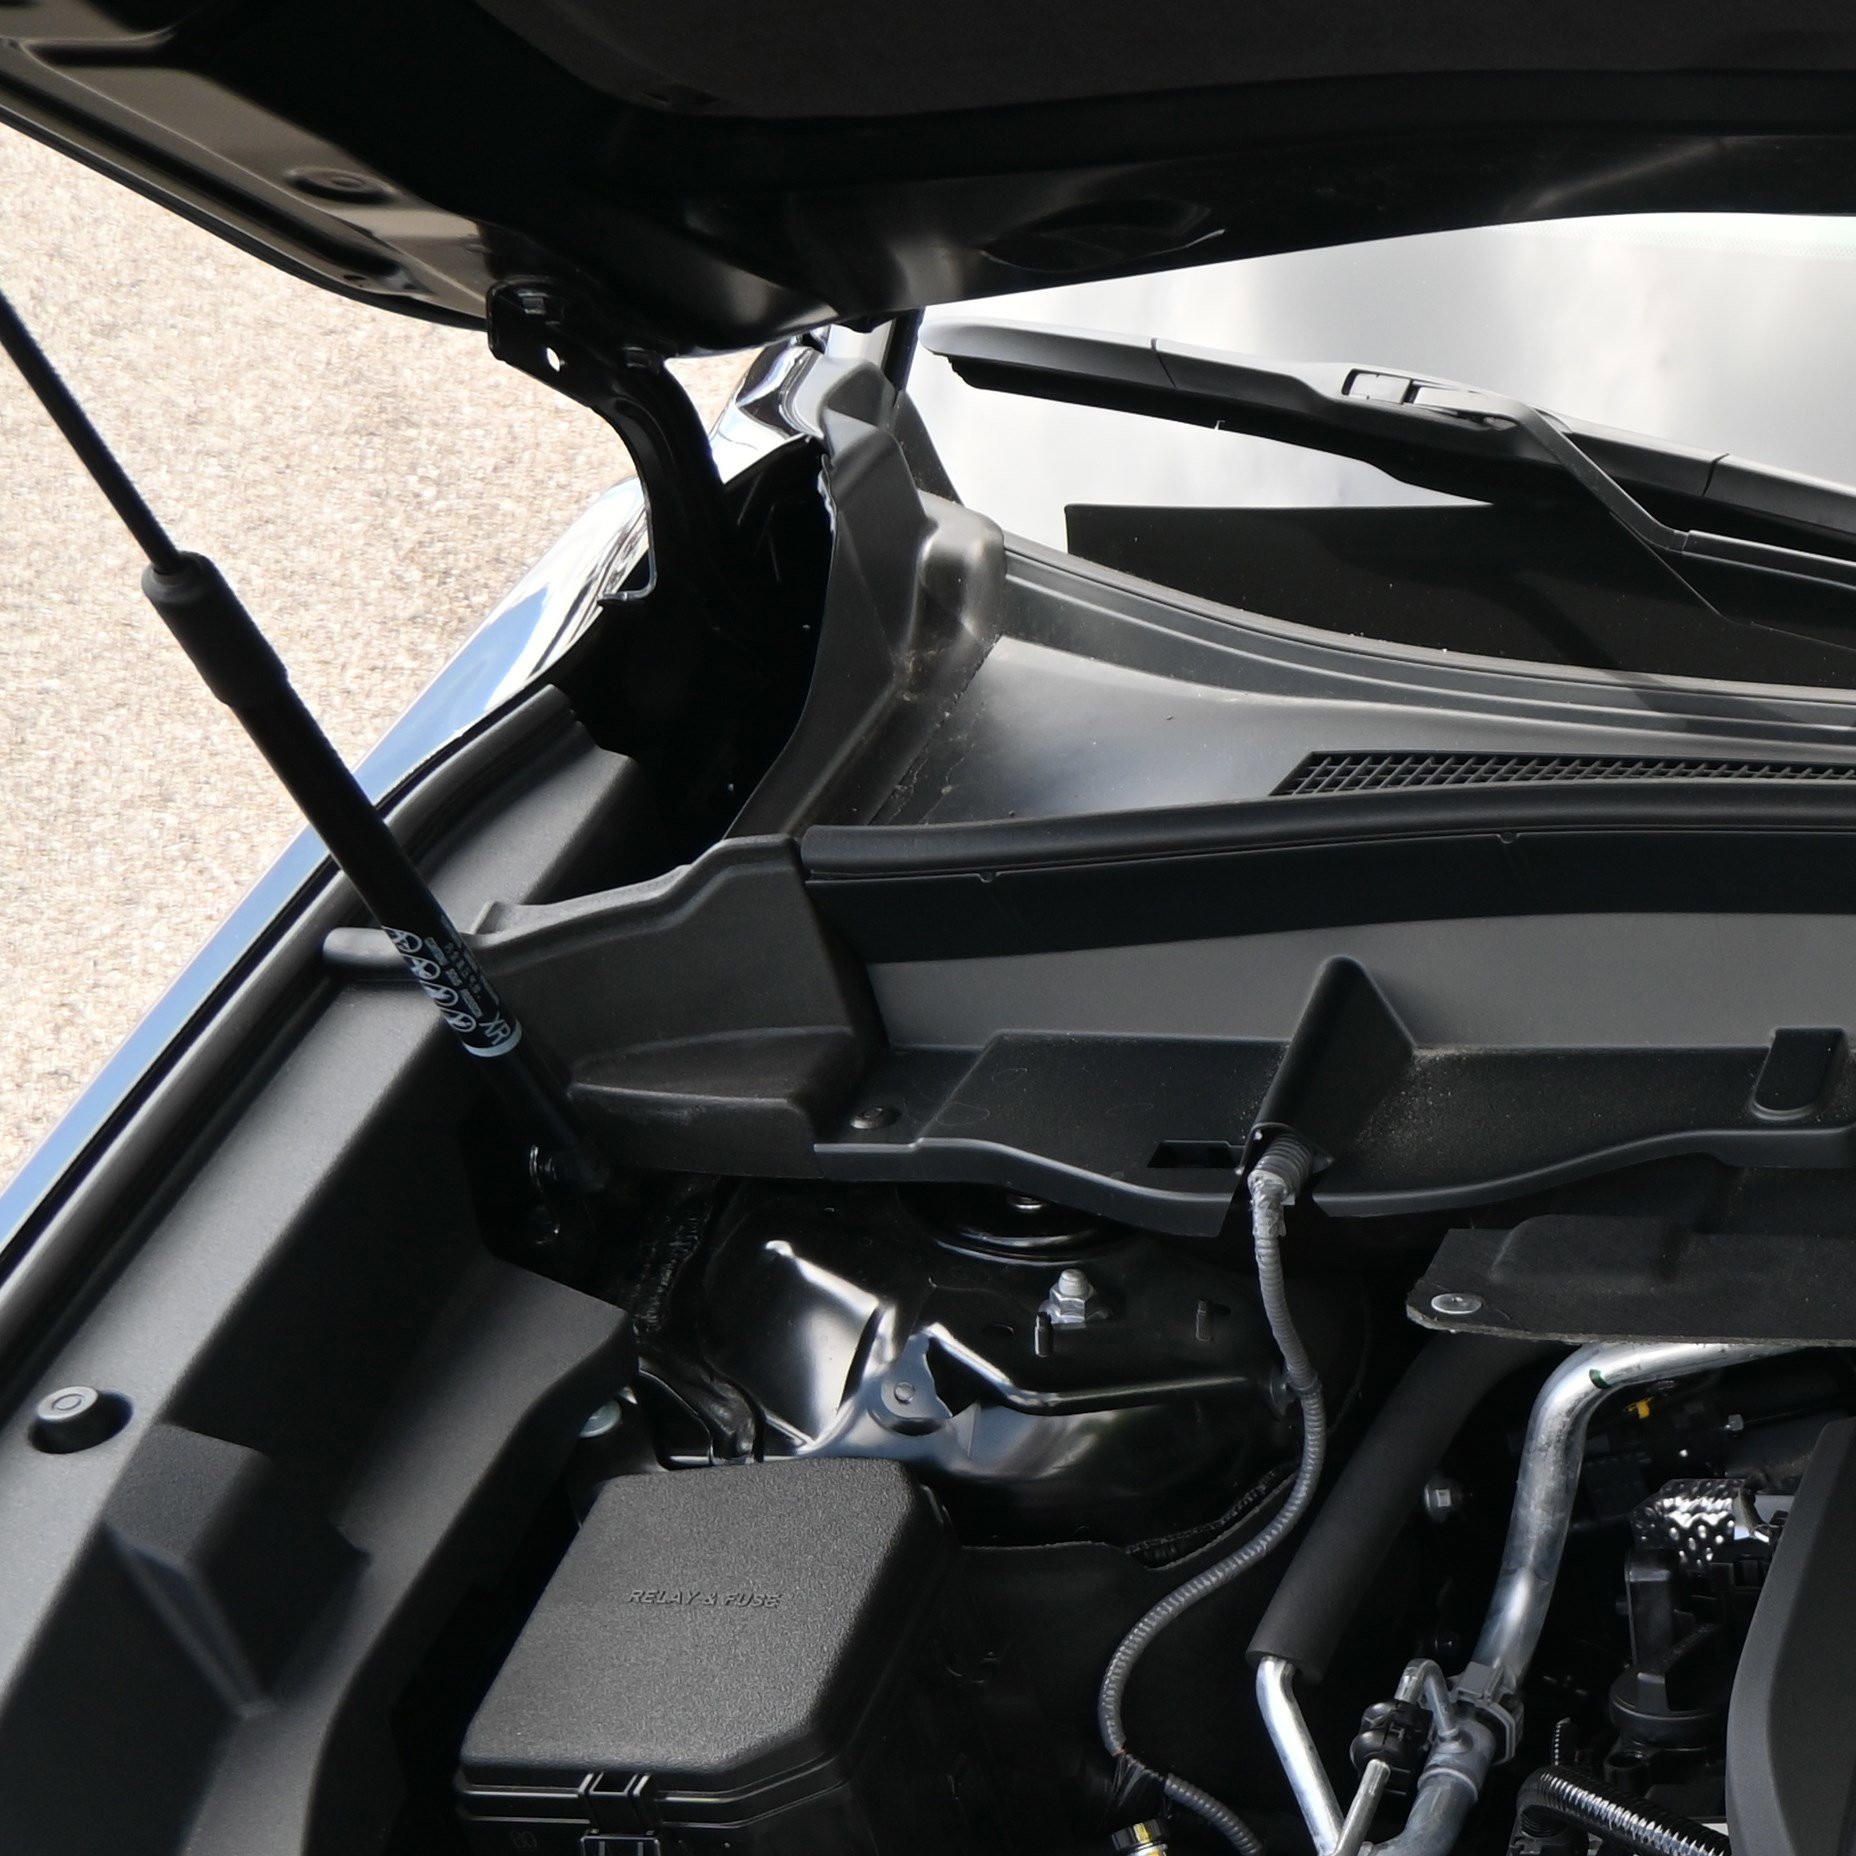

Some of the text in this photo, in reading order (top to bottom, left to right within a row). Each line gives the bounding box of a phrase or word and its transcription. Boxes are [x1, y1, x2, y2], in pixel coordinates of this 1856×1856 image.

[628, 1589, 781, 1609] RELAY & FUSE
